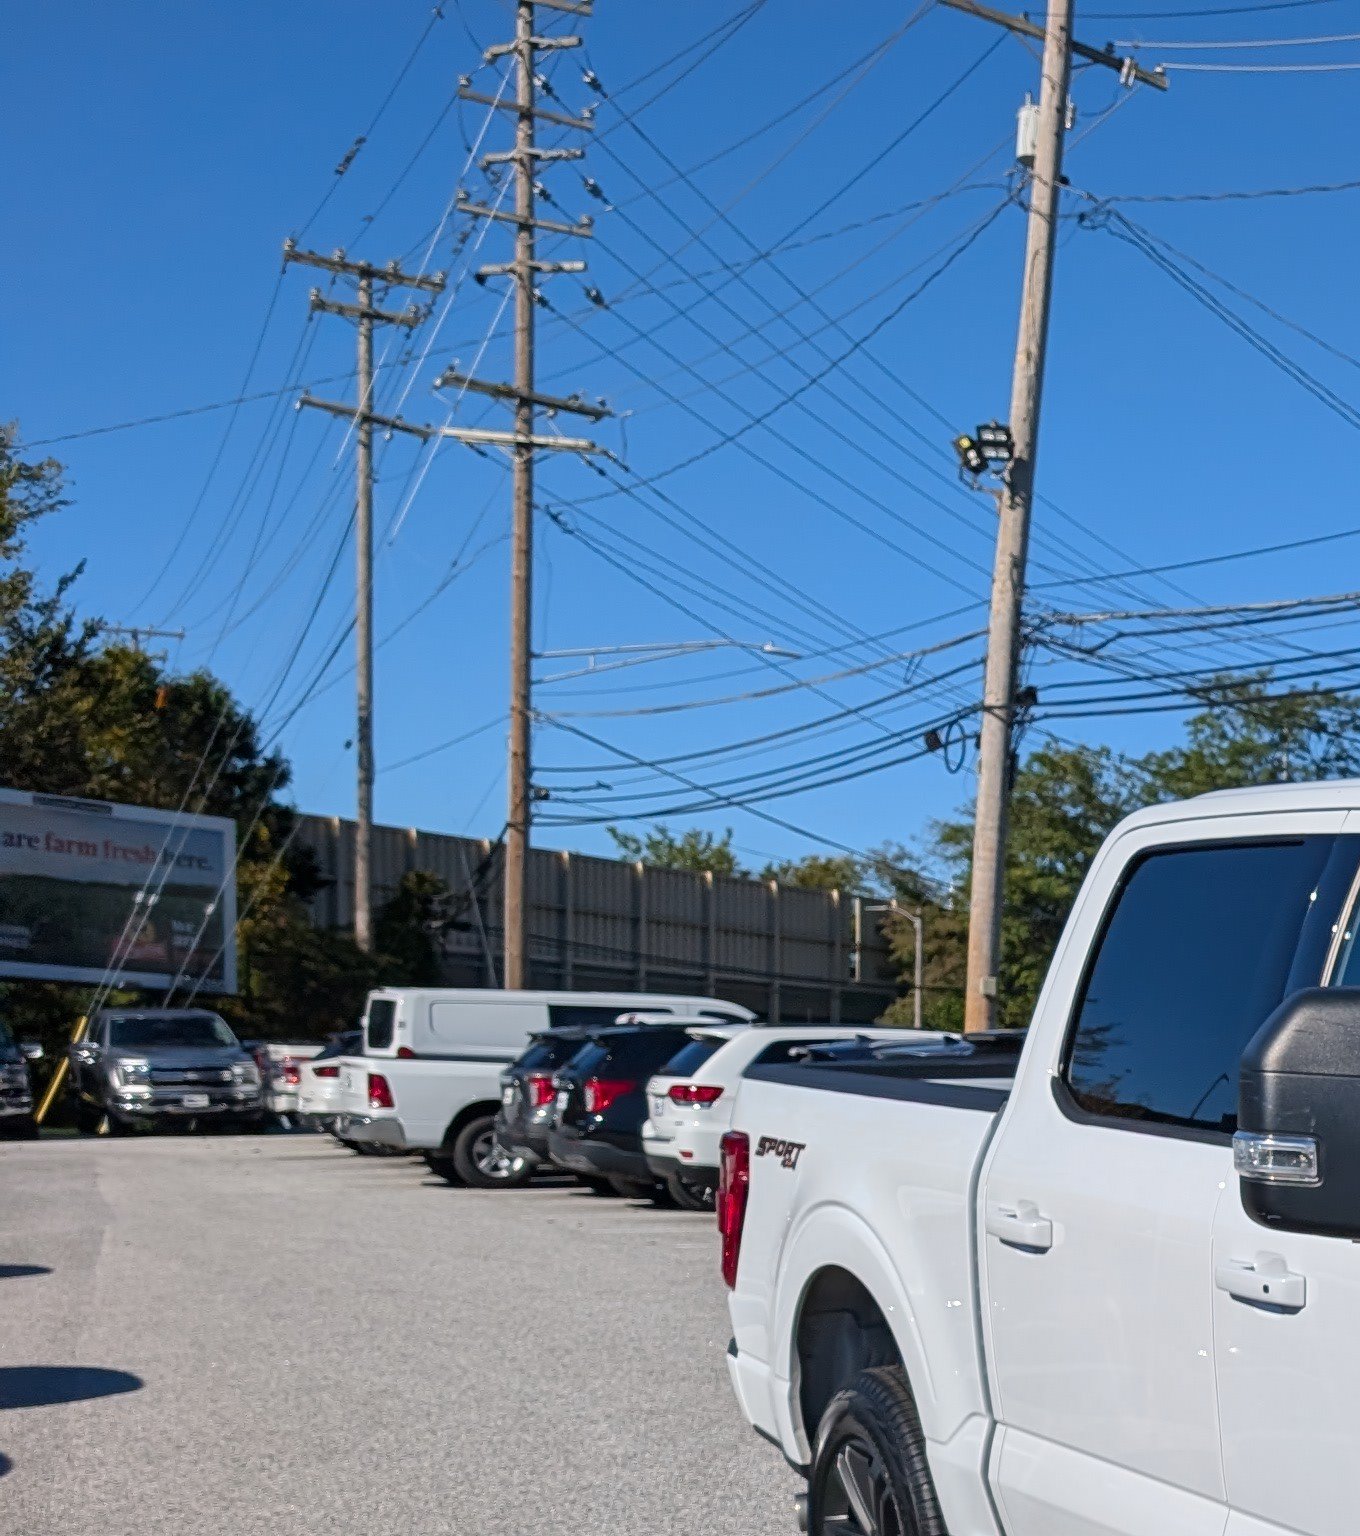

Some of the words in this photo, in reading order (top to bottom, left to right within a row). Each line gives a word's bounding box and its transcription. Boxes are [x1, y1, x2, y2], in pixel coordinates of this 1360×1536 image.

[43, 831, 98, 858] farm
[102, 839, 158, 864] fresh
[755, 1136, 806, 1163] SPORT
